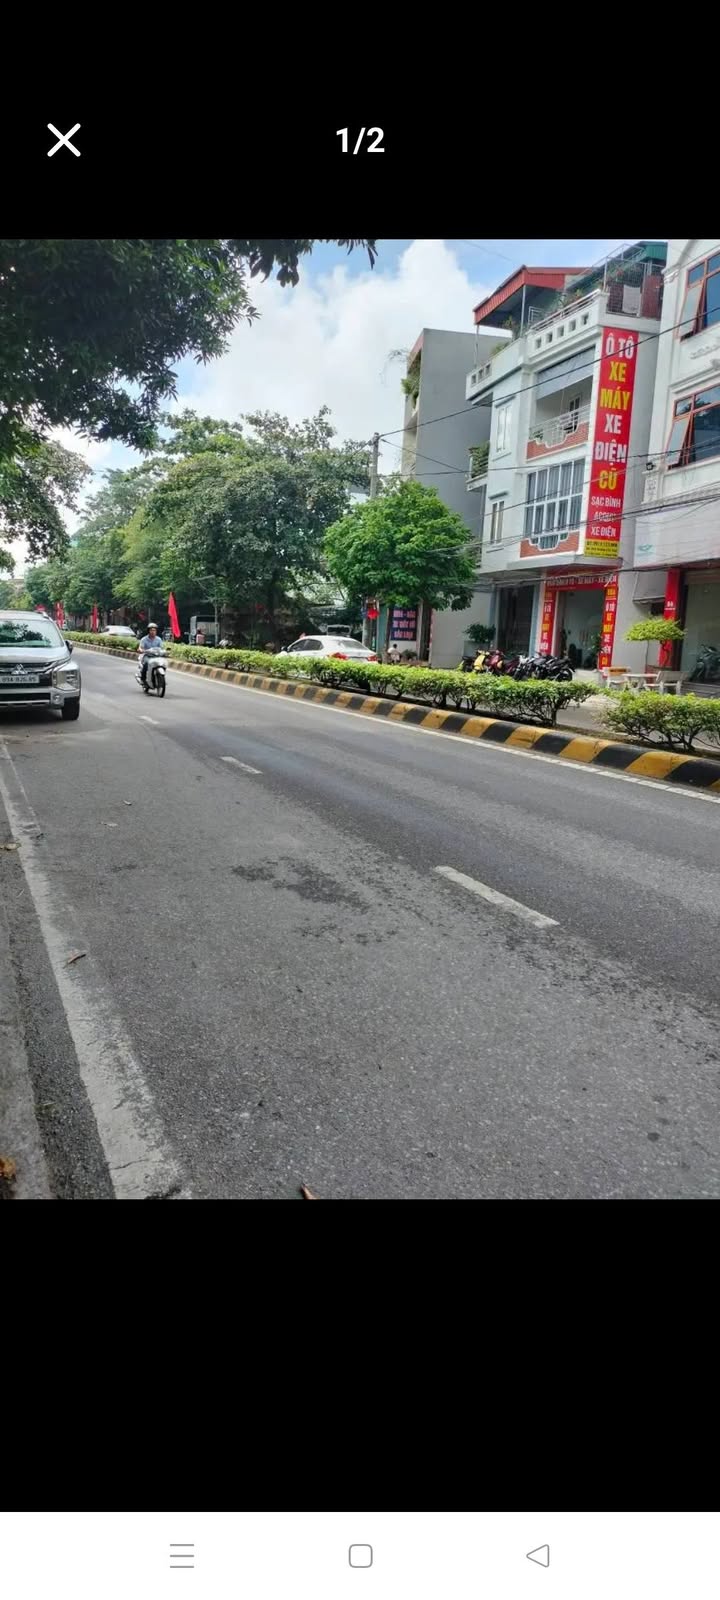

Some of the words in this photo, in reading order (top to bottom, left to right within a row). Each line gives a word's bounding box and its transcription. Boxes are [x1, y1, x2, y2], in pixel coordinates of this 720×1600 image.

[605, 332, 615, 356] Ô
[618, 336, 635, 360] TÔ
[609, 361, 627, 382] XE
[600, 386, 631, 410] MÁY
[604, 413, 623, 435] XE
[595, 438, 628, 467] ĐIỆN
[598, 467, 619, 490] CŨ
[591, 496, 605, 508] SẠC
[590, 526, 600, 536] XE
